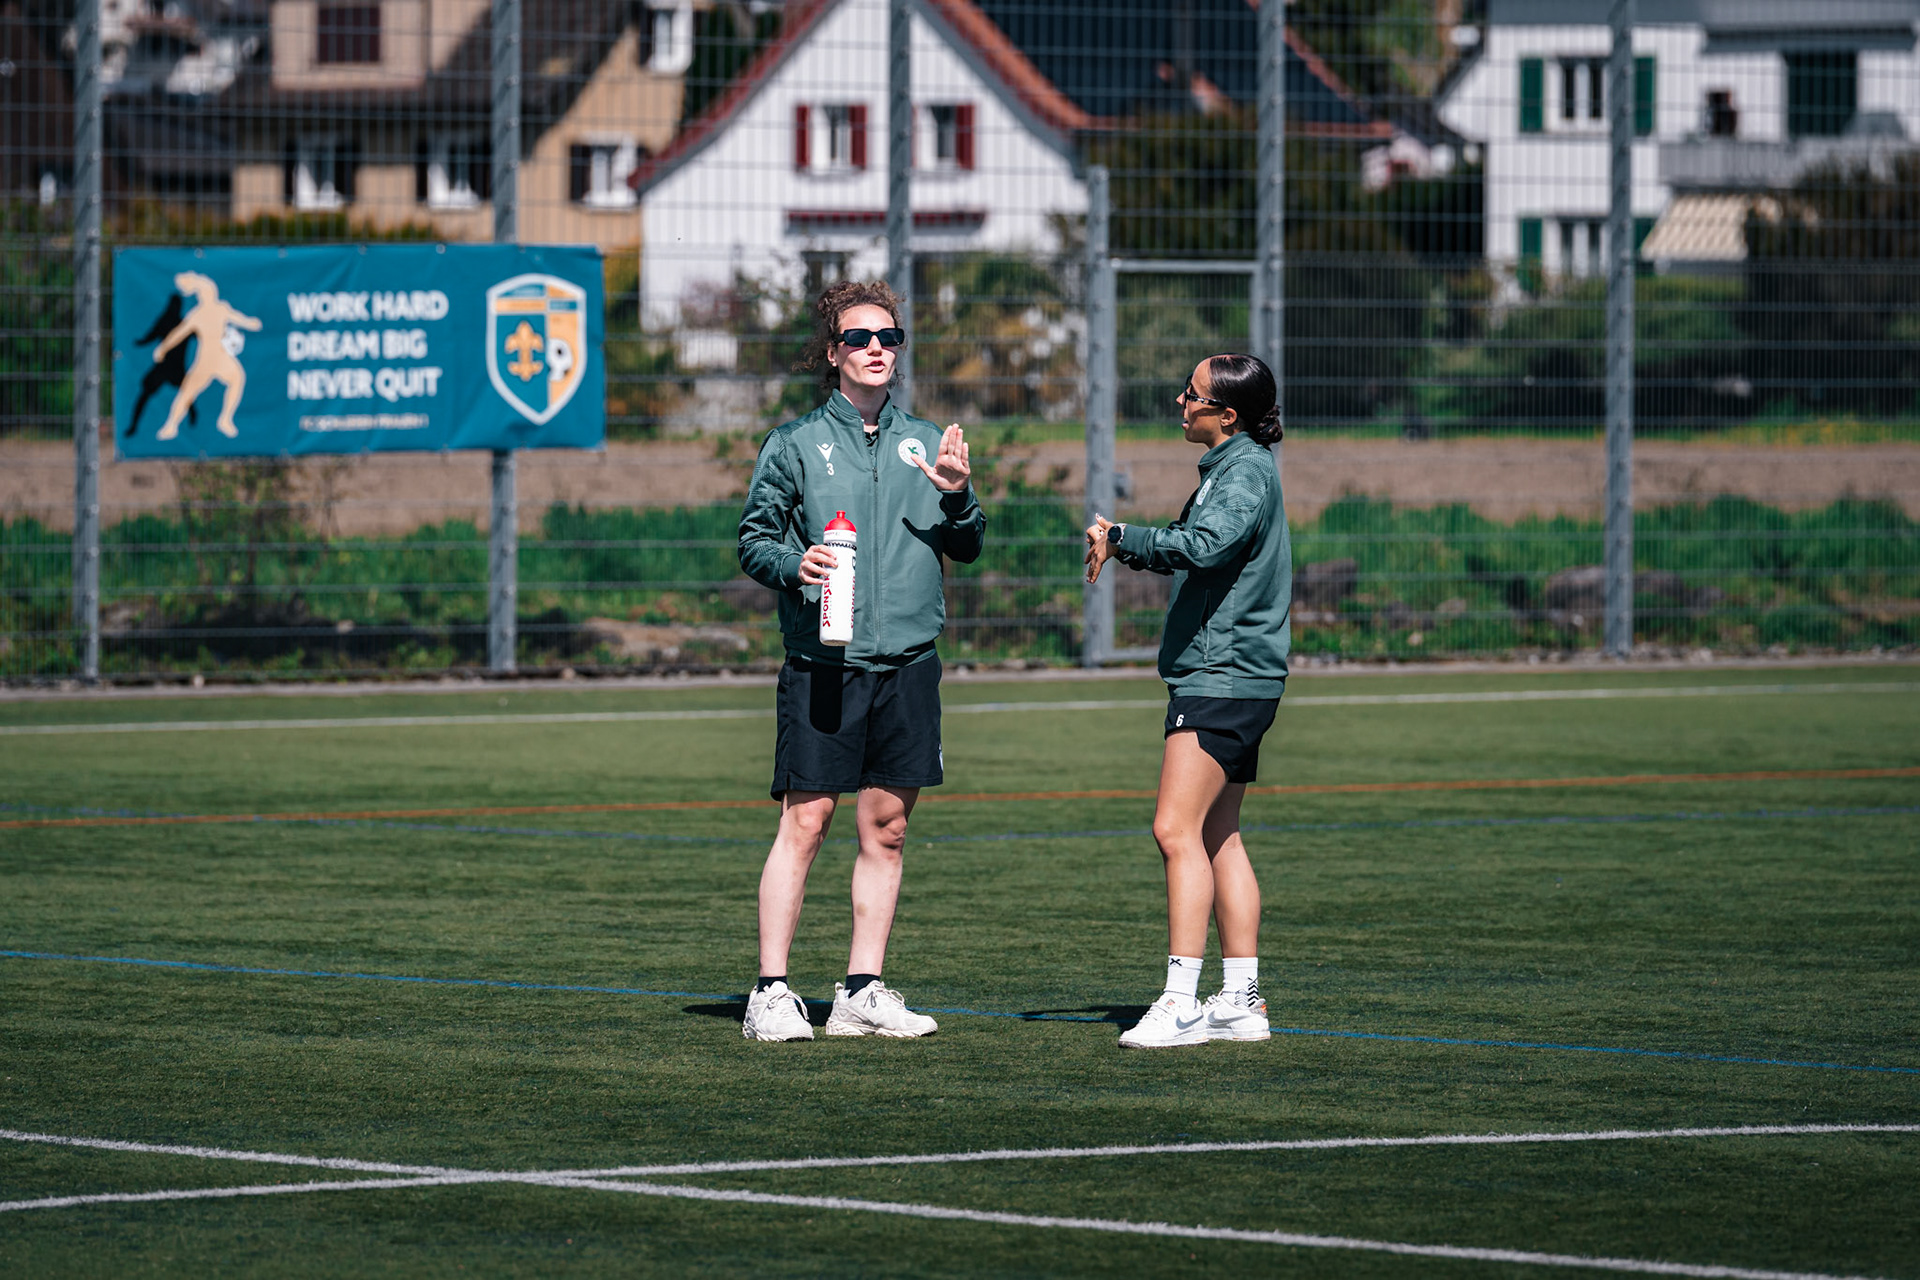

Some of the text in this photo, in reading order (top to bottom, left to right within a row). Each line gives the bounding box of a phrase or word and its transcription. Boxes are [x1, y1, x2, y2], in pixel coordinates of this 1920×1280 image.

[287, 290, 449, 322] WORK HARD
[287, 328, 428, 361] DREAM BIG
[287, 366, 443, 402] NEVER QUIT
[826, 462, 834, 476] 3
[1176, 714, 1185, 727] 6
